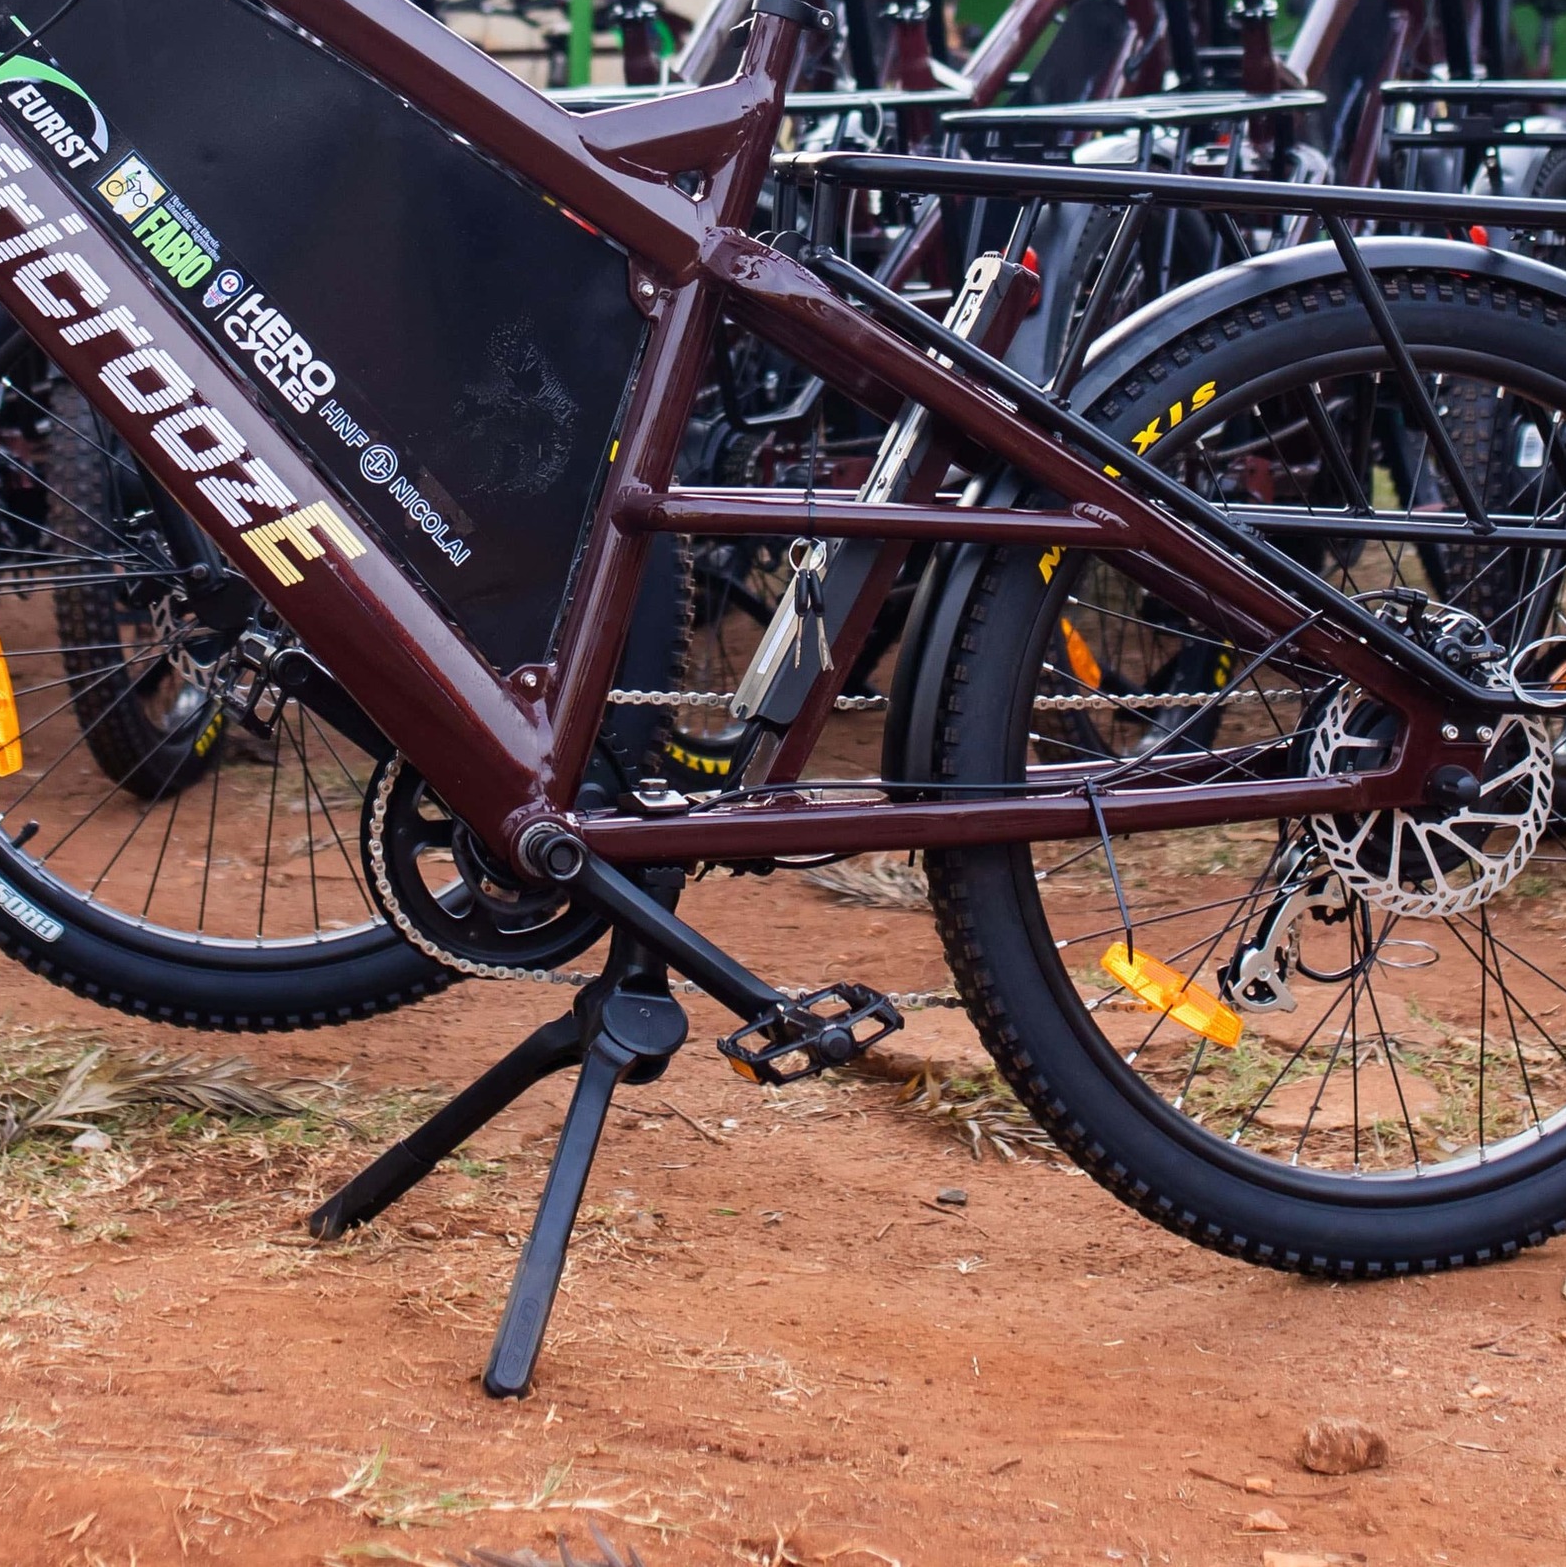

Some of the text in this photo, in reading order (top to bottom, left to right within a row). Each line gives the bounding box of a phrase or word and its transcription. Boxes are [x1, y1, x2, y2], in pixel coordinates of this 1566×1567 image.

[7, 83, 100, 171] EURIST
[132, 205, 214, 289] FABIO
[223, 314, 316, 415] CYCLES
[236, 292, 337, 397] HERO
[318, 398, 370, 449] HNF
[388, 475, 472, 567] NICOLAI
